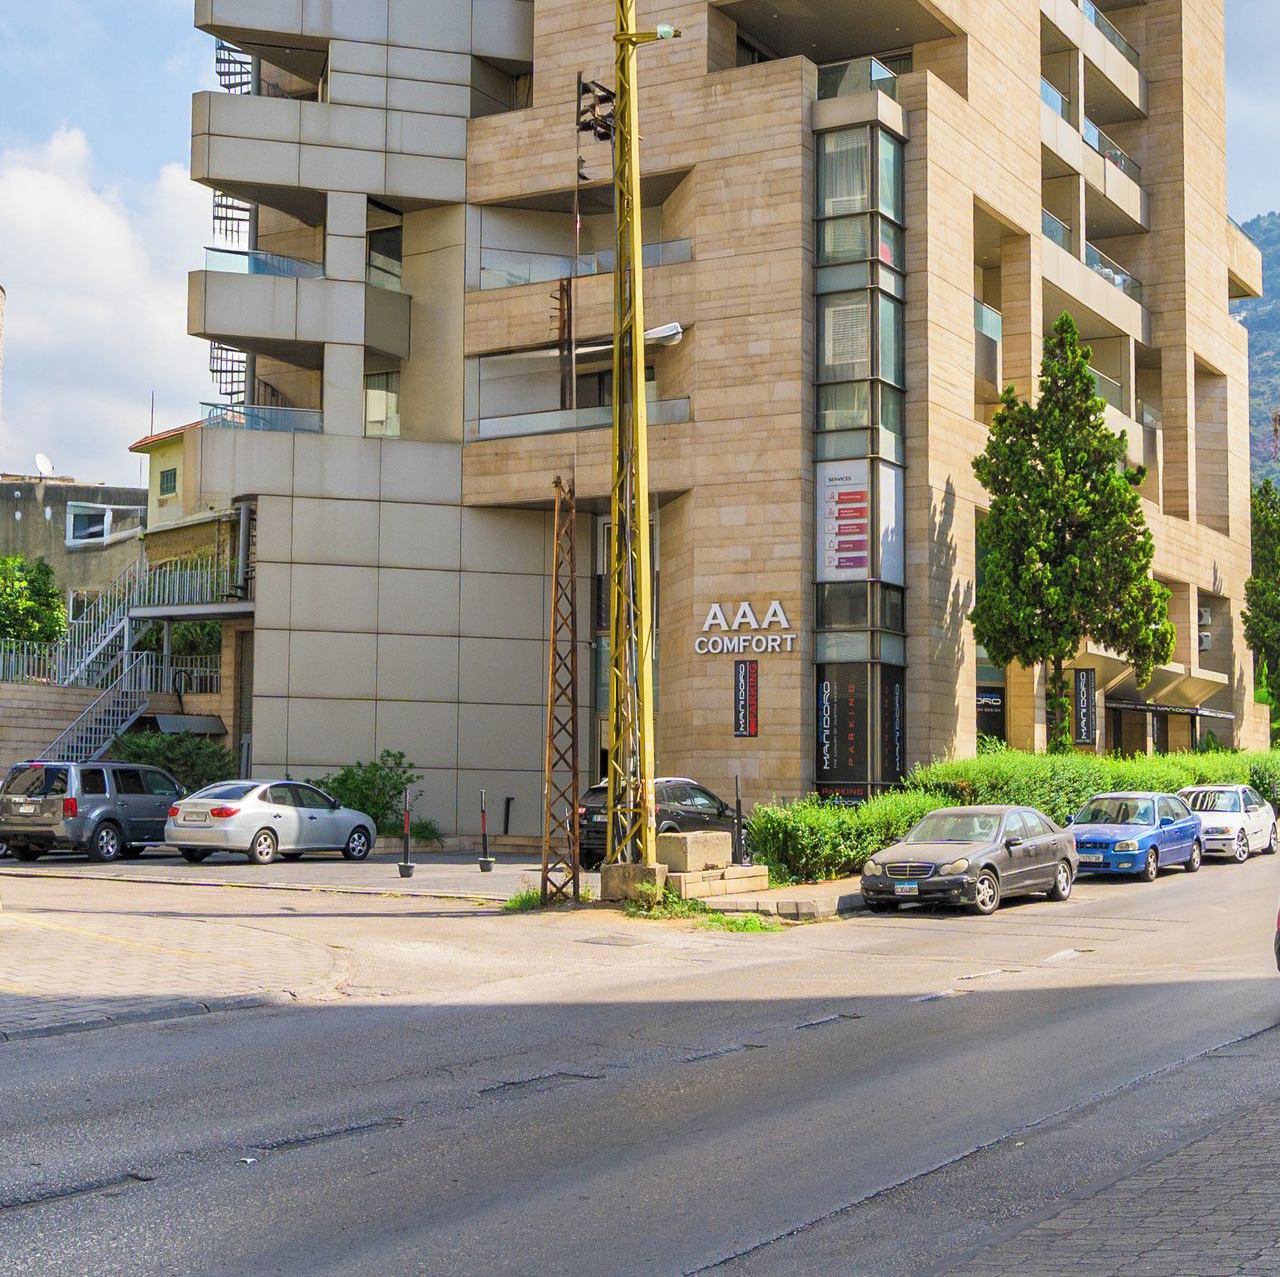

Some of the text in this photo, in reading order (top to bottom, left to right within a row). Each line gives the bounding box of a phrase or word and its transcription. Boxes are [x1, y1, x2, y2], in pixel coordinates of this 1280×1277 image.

[702, 600, 790, 631] AAA
[694, 633, 797, 653] COMFORT
[749, 663, 757, 722] PARKING
